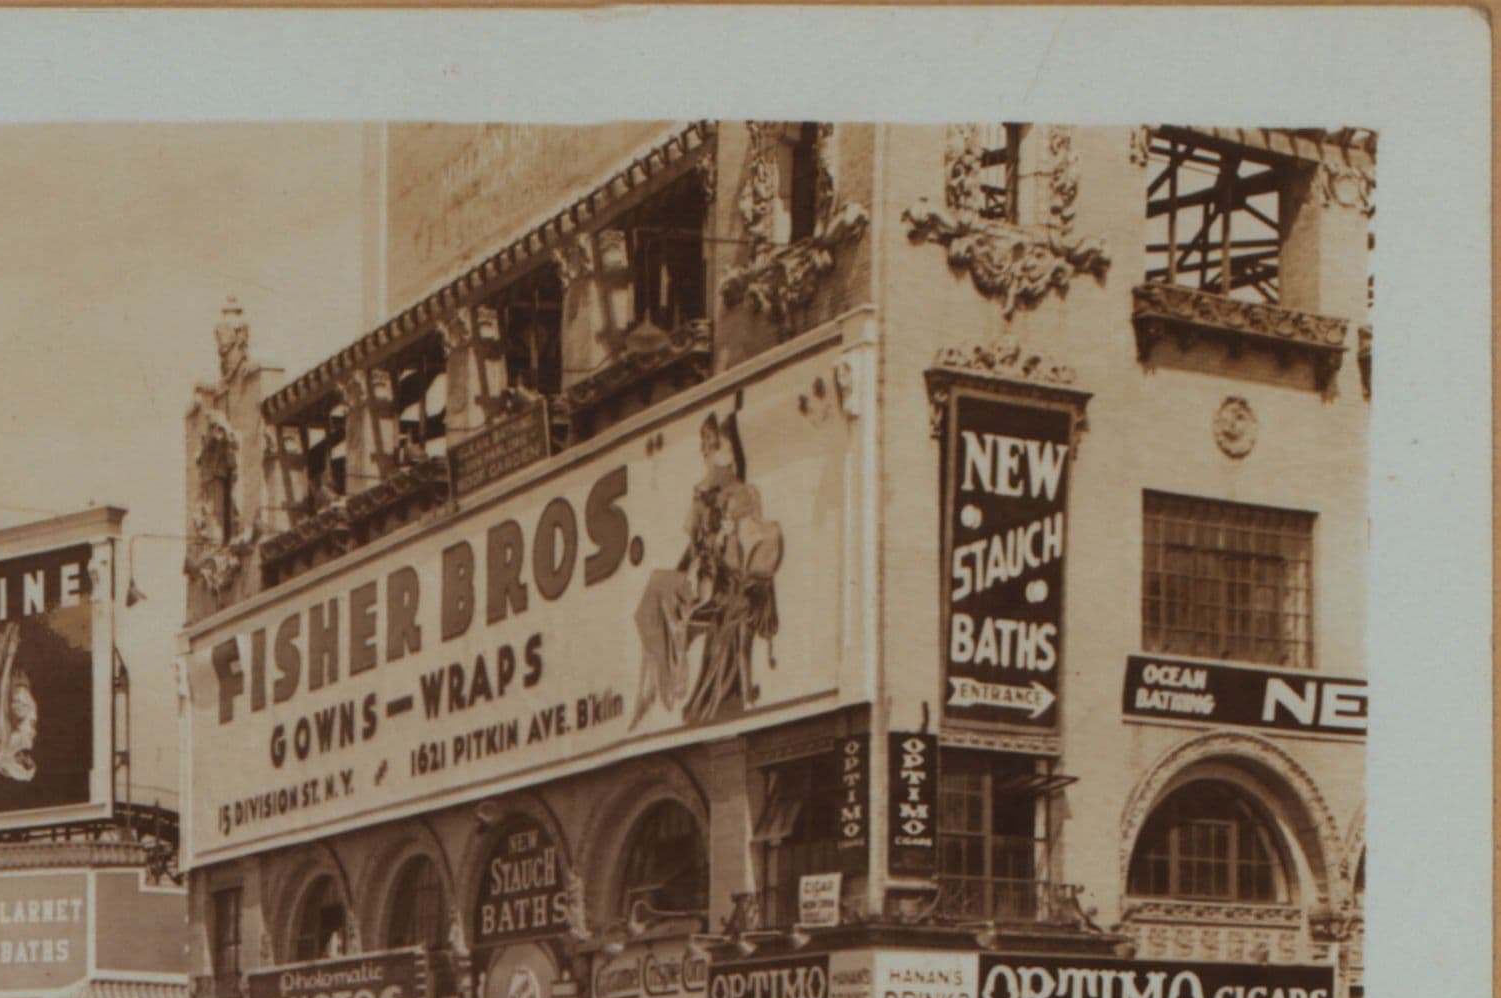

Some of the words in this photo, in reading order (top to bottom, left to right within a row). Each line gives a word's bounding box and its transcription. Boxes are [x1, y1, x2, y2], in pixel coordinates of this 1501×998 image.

[960, 430, 1068, 502] NEW
[952, 512, 1063, 602] STAUCH
[211, 566, 421, 725] FISHER
[441, 465, 644, 642] BROS.
[951, 613, 1057, 672] BATHS
[271, 693, 379, 768] GOWNS
[420, 633, 543, 720] WRAPS
[959, 683, 1043, 706] ENTRANCE
[1134, 688, 1216, 714] BATHING
[1142, 664, 1207, 690] OCEAN
[218, 804, 230, 837] 15
[235, 784, 298, 827] DIVISION
[410, 741, 446, 777] 1621
[453, 718, 518, 766] PITKIN
[526, 703, 571, 745] AVE.
[840, 740, 862, 838] OPTIMO
[899, 738, 929, 835] OPTIMO
[508, 829, 539, 854] NEW
[490, 847, 556, 896] STAUCH
[481, 892, 568, 935] BATHS
[0, 939, 70, 964] BATHS
[280, 962, 384, 996] Photomatic
